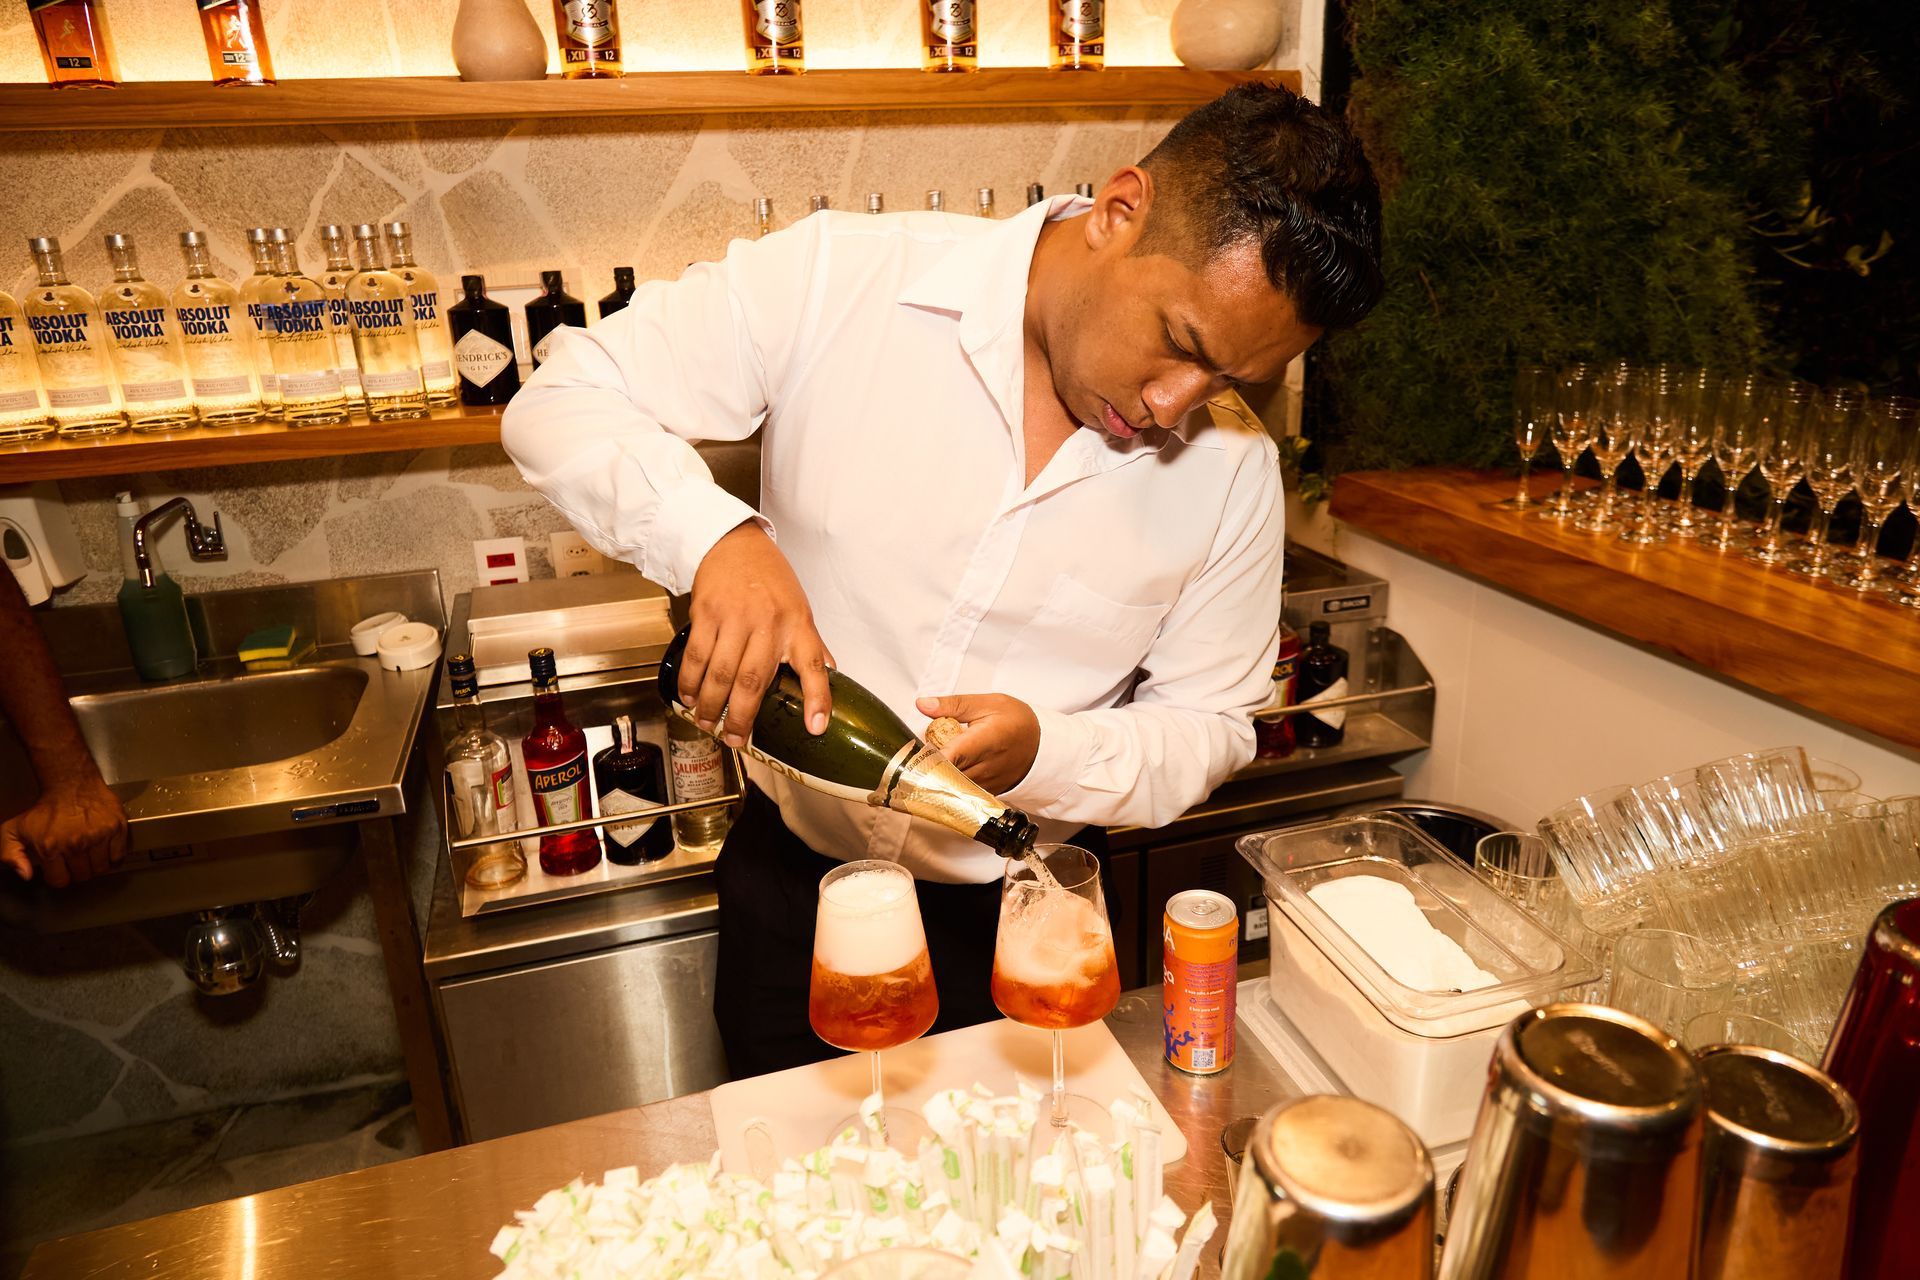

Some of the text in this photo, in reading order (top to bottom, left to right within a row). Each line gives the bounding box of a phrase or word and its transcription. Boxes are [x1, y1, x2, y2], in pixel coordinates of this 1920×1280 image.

[234, 53, 246, 63] 12
[605, 50, 615, 60] 12
[793, 48, 801, 58] 12
[965, 47, 973, 56] 12
[69, 58, 80, 67] 12
[349, 299, 404, 315] ABSOLUT
[411, 292, 437, 307] OLUT
[105, 308, 165, 325] ABSOLUT
[175, 305, 231, 321] ABSOLUT
[267, 301, 325, 319] ABSOLUT
[413, 306, 437, 320] DKA
[28, 313, 88, 330] ABSOLUT
[181, 320, 229, 335] VODKA
[274, 317, 323, 334] VODKA
[354, 313, 403, 329] VODKA
[34, 328, 87, 344] VODKA
[112, 323, 164, 339] VODKA
[535, 764, 583, 790] APEROL
